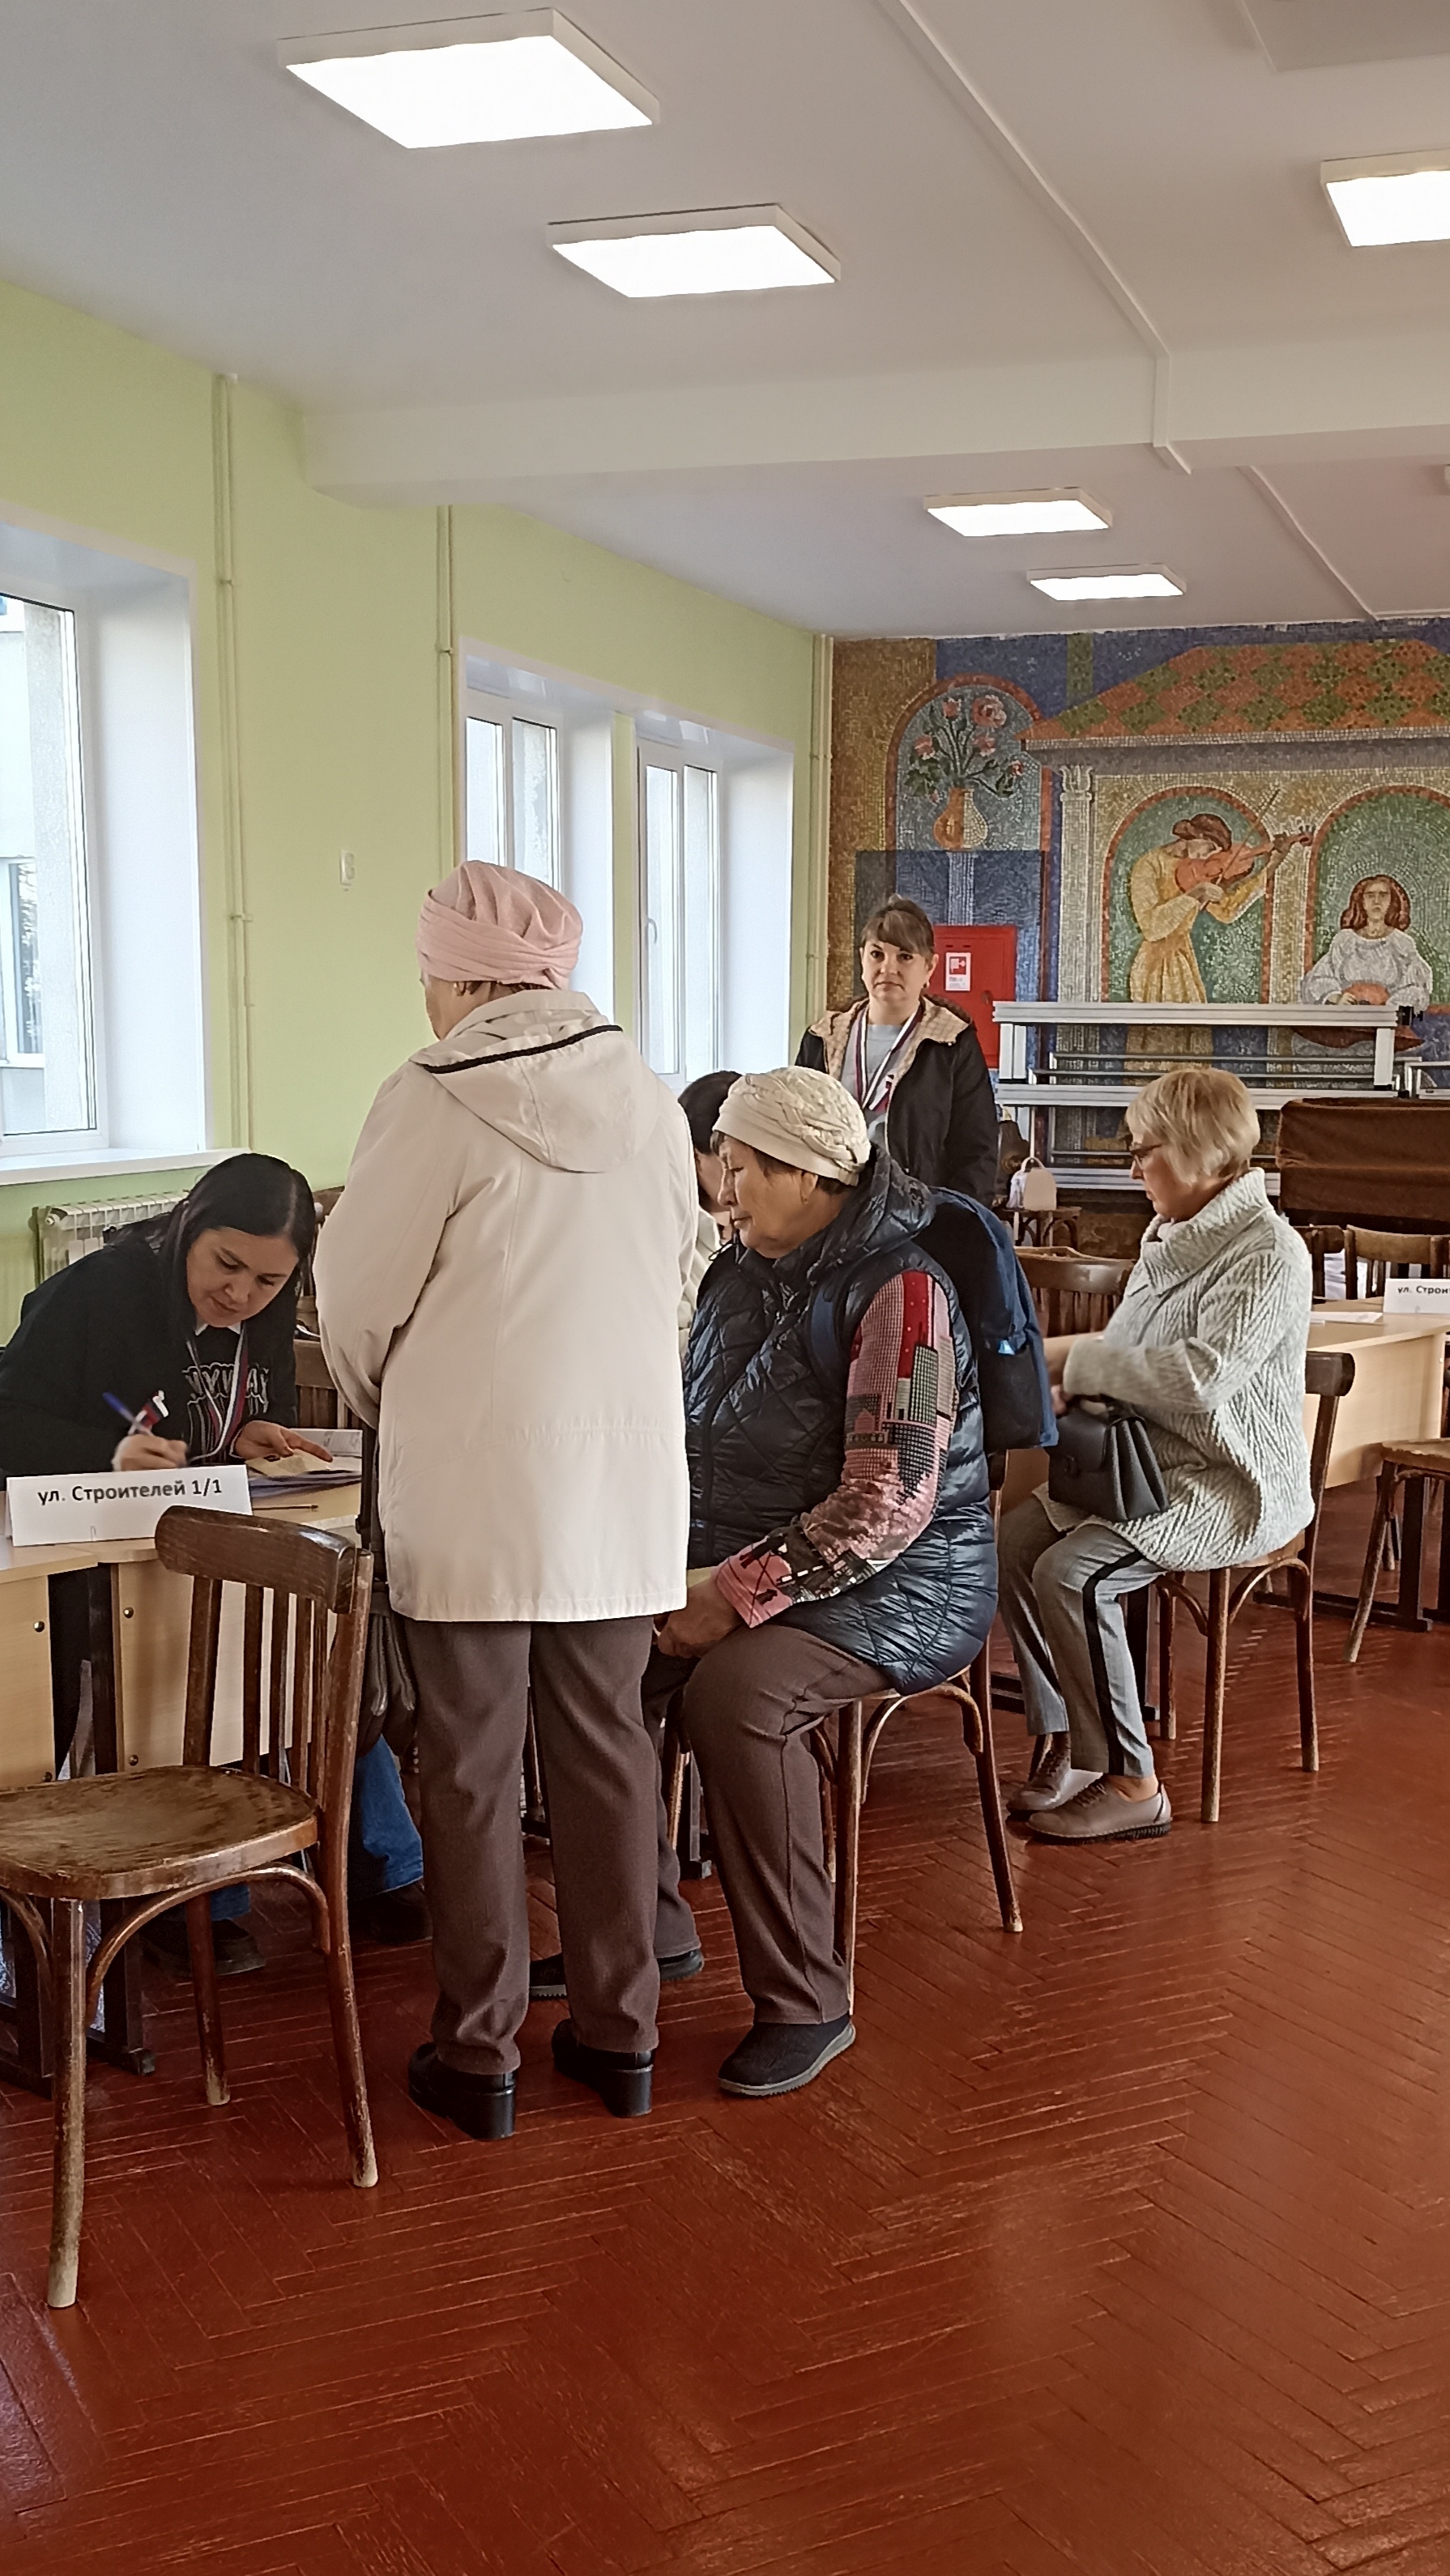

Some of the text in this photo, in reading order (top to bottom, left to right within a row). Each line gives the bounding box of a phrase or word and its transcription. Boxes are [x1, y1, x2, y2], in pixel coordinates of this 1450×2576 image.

[37, 1477, 223, 1505] ул. Строителей 1/1
